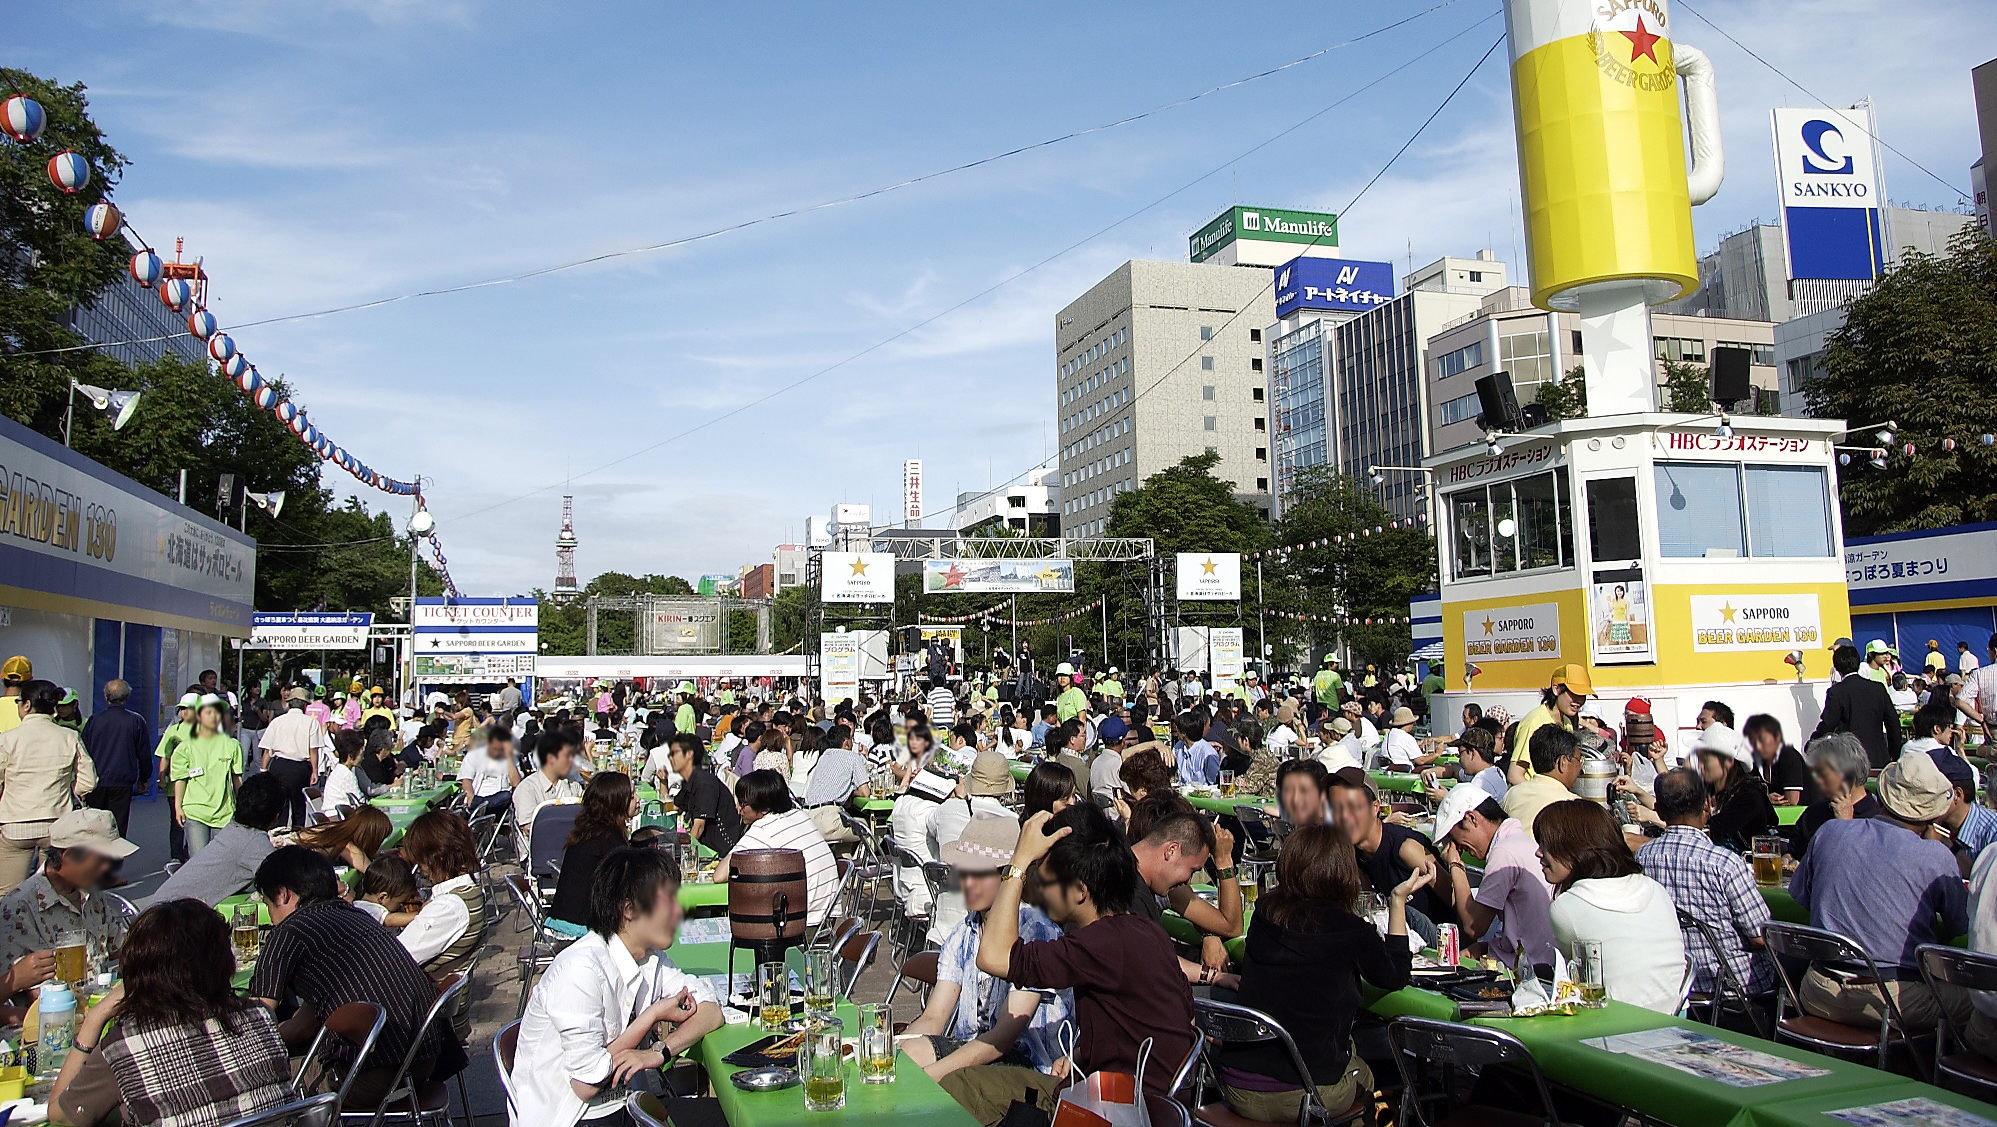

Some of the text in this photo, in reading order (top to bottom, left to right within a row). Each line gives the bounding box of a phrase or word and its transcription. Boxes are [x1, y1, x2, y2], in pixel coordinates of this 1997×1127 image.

[1598, 51, 1638, 89] BEER
[1794, 182, 1867, 197] SANKYO
[1200, 219, 1233, 250] Manulife
[1263, 216, 1333, 236] Manulife
[1304, 286, 1393, 305] アートネイチャー
[910, 462, 920, 517] 三井生命
[87, 502, 117, 563] 130
[167, 533, 242, 582] 北海道はサッポロビール
[1844, 550, 1888, 563] 涼ガーデン
[1846, 558, 1948, 582] っぽろ夏まつり
[422, 607, 533, 618] TICKET COUNTER
[1742, 607, 1790, 620] SAPPORO
[1498, 618, 1534, 631] SAPPORO
[257, 636, 359, 644] SAPPORO BEER GARDEN
[1467, 635, 1557, 655] BEER GARDEN 130
[1697, 626, 1817, 645] BEER GARDEN 130
